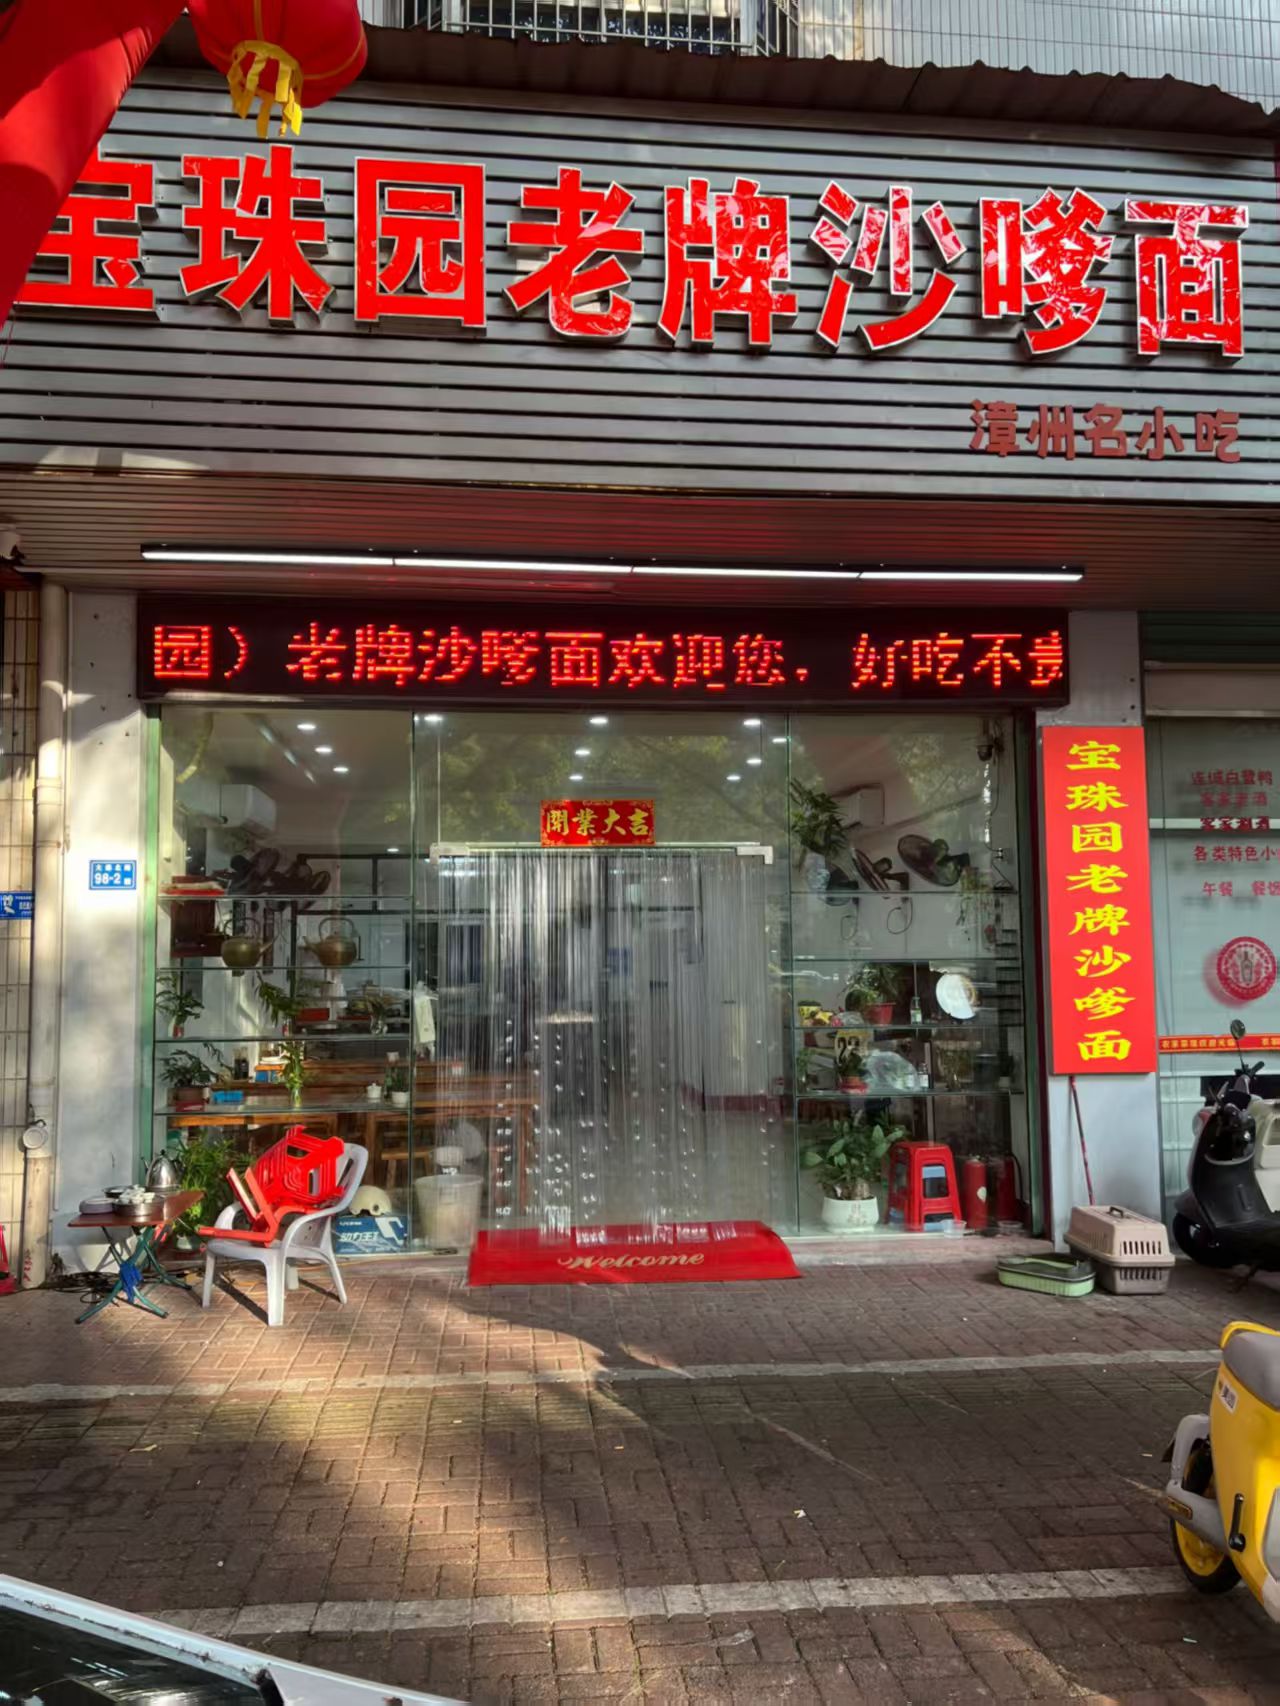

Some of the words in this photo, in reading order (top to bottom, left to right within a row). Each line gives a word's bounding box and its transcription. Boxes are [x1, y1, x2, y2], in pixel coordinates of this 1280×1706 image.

[970, 400, 1241, 463] 漳州名小吃
[1194, 845, 1280, 862] 各类特色小
[1065, 741, 1136, 1062] 宝珠园老牌沙嗲面
